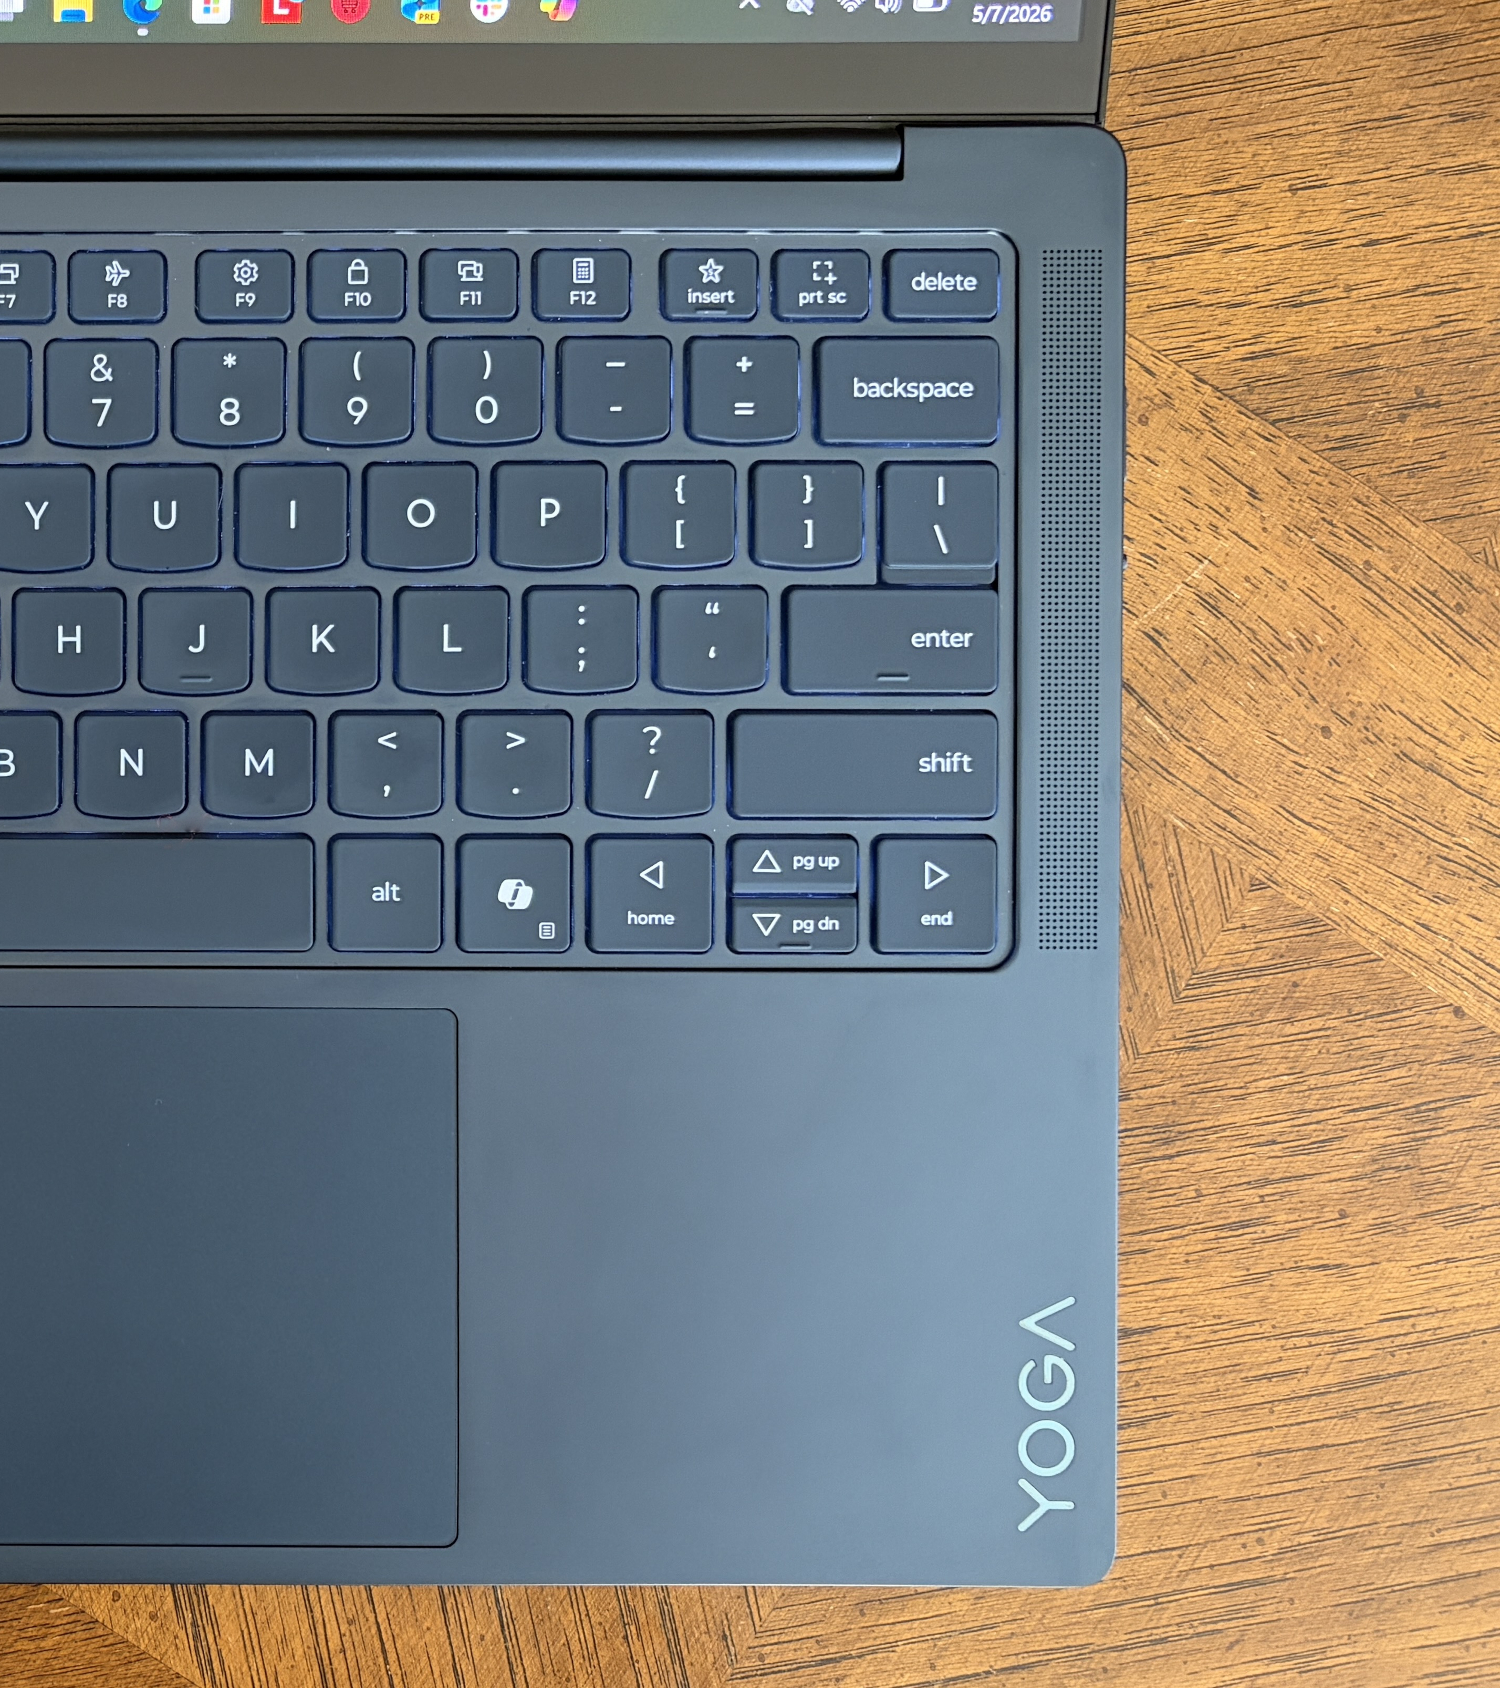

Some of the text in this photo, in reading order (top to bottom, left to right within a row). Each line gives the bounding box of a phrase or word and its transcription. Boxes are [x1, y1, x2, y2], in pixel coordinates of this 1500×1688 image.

[418, 12, 436, 21] PRE
[971, 4, 1053, 25] 5/7/2026
[911, 271, 978, 291] delete
[107, 293, 128, 309] F8
[235, 292, 256, 308] F9
[344, 291, 372, 307] F10
[459, 290, 482, 306] F11
[569, 290, 597, 306] F12
[687, 288, 736, 304] insert
[798, 290, 847, 307] prt sc
[90, 353, 114, 382] &
[353, 350, 362, 381] (
[482, 350, 492, 380] )
[735, 356, 753, 373] +
[853, 376, 975, 403] backspace
[91, 398, 113, 428] 7
[219, 397, 241, 426] 8
[346, 396, 369, 425] 9
[734, 402, 755, 416] =
[24, 501, 49, 531] Y
[153, 500, 177, 530] U
[406, 498, 436, 528] O
[540, 497, 561, 527] P
[675, 519, 685, 549] [
[803, 519, 814, 549] ]
[933, 524, 949, 555] \
[577, 605, 586, 626] :
[57, 624, 82, 654] H
[188, 624, 206, 653] J
[311, 624, 336, 653] K
[442, 623, 463, 653] L
[910, 629, 974, 648] enter
[577, 646, 586, 673] ;
[377, 731, 397, 750] <
[505, 731, 526, 750] >
[642, 725, 662, 755] ?
[119, 748, 144, 777] N
[244, 748, 274, 777] M
[918, 751, 973, 773] shift
[644, 769, 659, 800] /
[792, 855, 840, 871] pg up
[371, 881, 401, 902] alt
[627, 910, 676, 926] home
[792, 915, 840, 935] pg dn
[920, 910, 953, 926] end
[1017, 1296, 1076, 1532] YOGA
